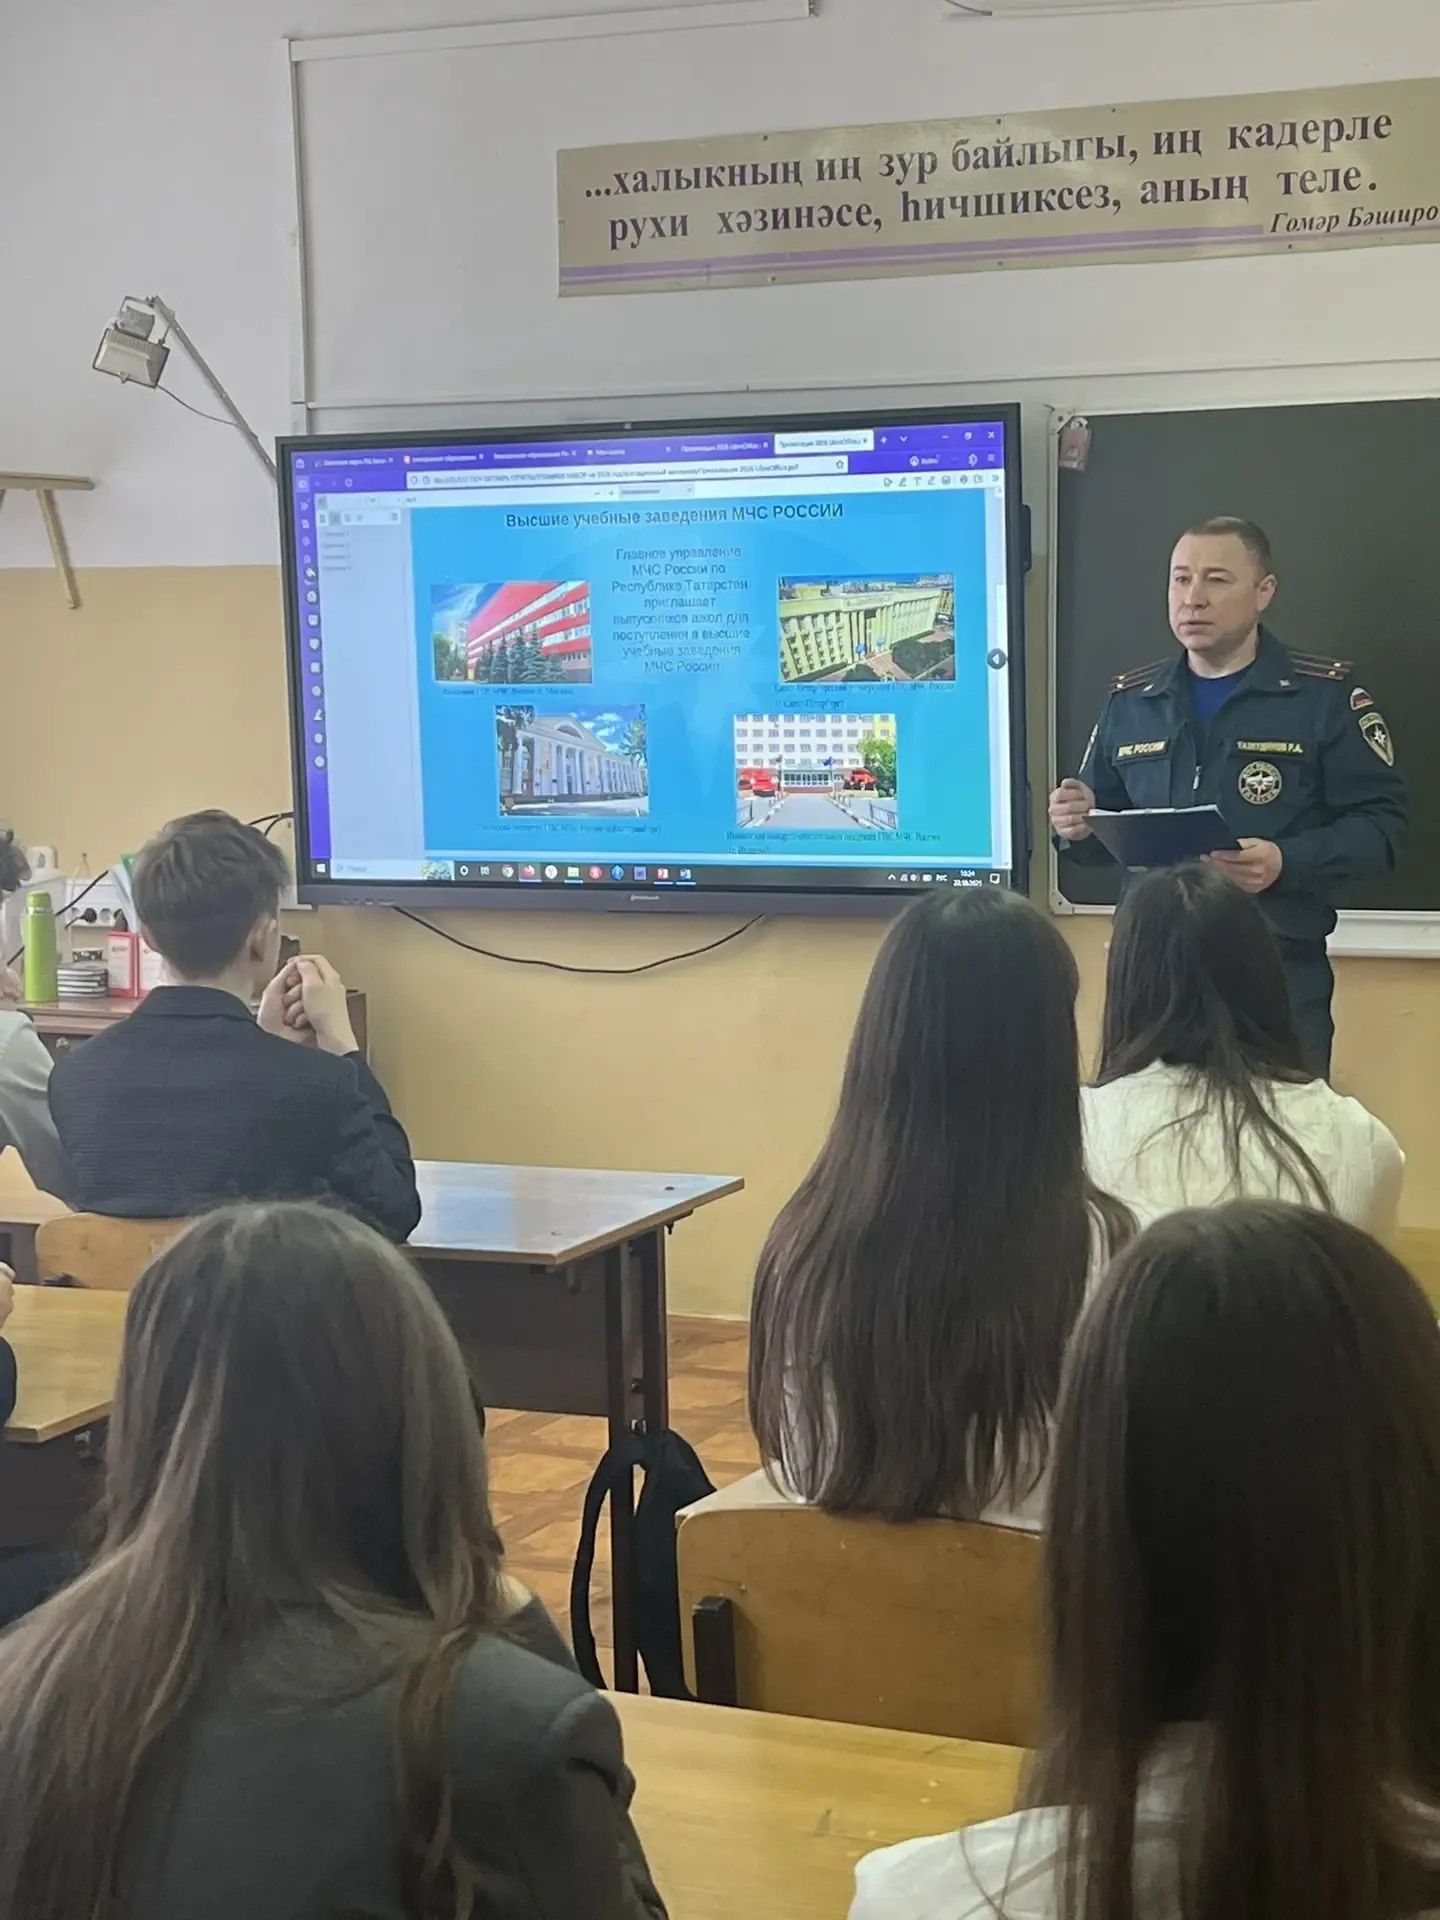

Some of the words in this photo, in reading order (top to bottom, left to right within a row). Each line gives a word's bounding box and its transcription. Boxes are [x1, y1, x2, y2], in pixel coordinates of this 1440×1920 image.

[584, 160, 803, 198] ...халыкның
[815, 155, 862, 182] иң
[879, 149, 938, 186] зур
[951, 133, 1138, 173] байлыгы,
[1152, 129, 1202, 156] иң
[1227, 114, 1393, 153] кадерле
[608, 213, 689, 250] рухи
[716, 202, 882, 236] хәзинәсе,
[900, 184, 1122, 223] һичшиксез,
[1139, 174, 1250, 205] аның
[1276, 165, 1378, 197] теле.
[1270, 211, 1340, 233] Гомәр
[506, 512, 569, 529] Высшие
[572, 510, 641, 530] учебные
[644, 507, 728, 526] заведения
[732, 504, 769, 521] МЧС
[772, 502, 844, 520] РОССИИ
[616, 549, 666, 561] Главное
[668, 547, 742, 561] управление
[632, 564, 661, 576] МЧС
[665, 563, 708, 576] России
[711, 564, 727, 574] по
[684, 579, 749, 592] Татарстан
[644, 597, 716, 610] приглашает
[613, 614, 689, 628] выпускников
[692, 613, 722, 624] школ
[726, 613, 750, 625] для
[612, 630, 689, 643] поступления
[692, 630, 699, 640] в
[702, 629, 751, 640] высшие
[622, 644, 674, 660] учебные
[678, 645, 741, 658] заведения
[644, 661, 673, 673] МЧС
[676, 660, 721, 673] России
